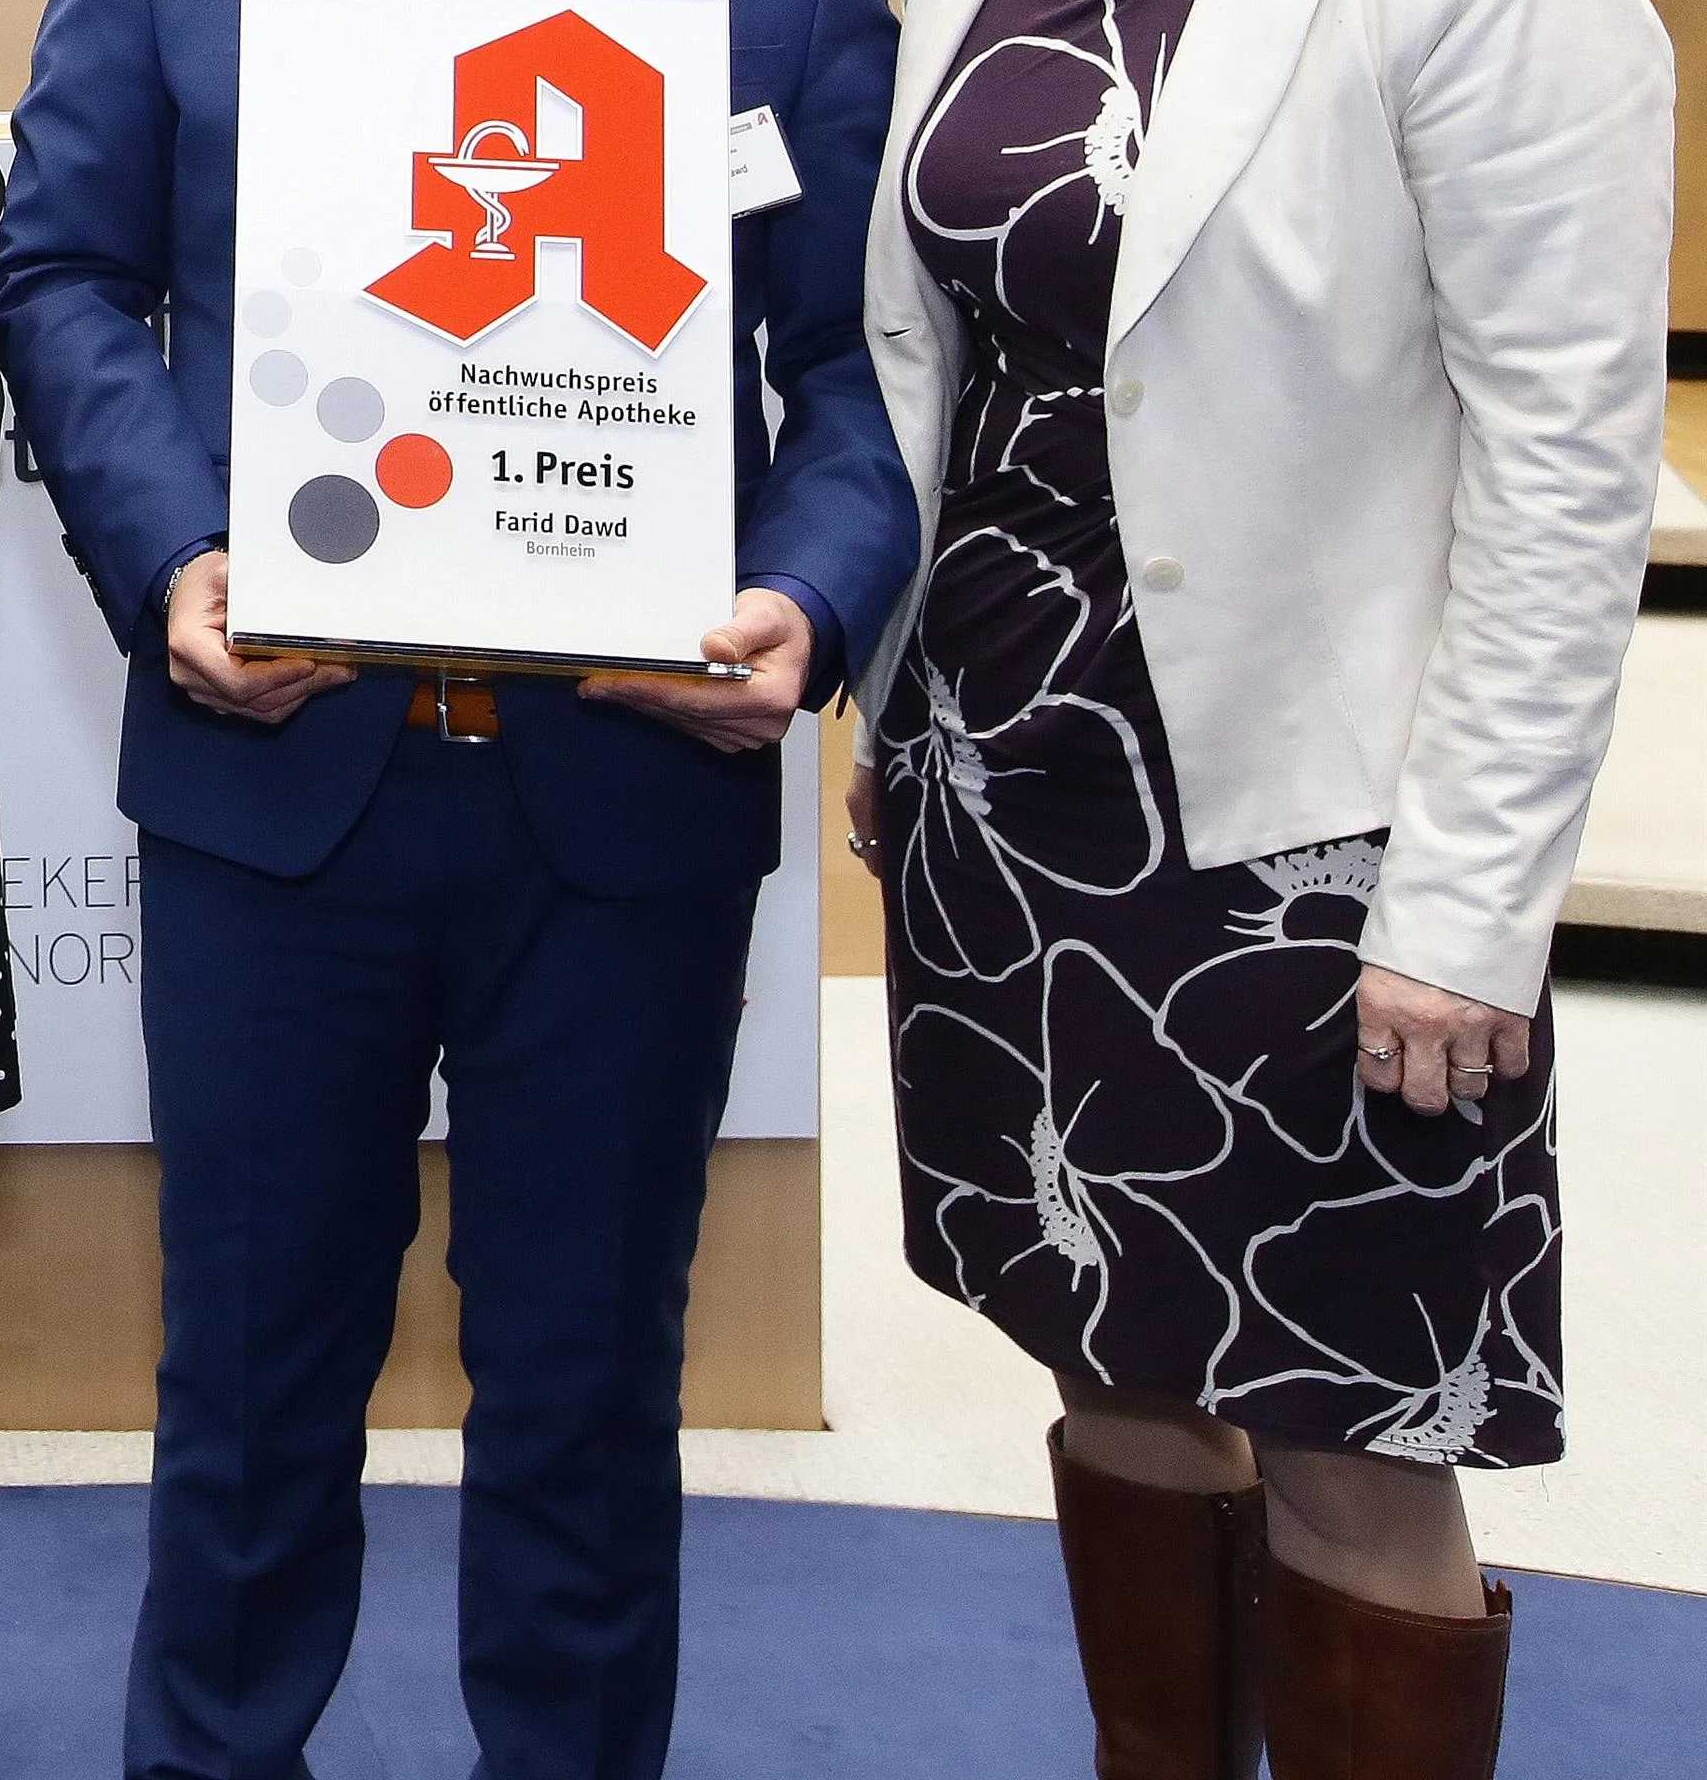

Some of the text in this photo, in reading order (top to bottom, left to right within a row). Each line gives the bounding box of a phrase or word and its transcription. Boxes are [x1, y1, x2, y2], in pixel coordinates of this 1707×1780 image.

[460, 363, 657, 396] Nachwuchspreis
[428, 391, 696, 426] öffentliche Apotheke
[491, 450, 634, 489] 1. Preis
[495, 511, 628, 538] Farid Dawd
[526, 541, 596, 558] Bornheim
